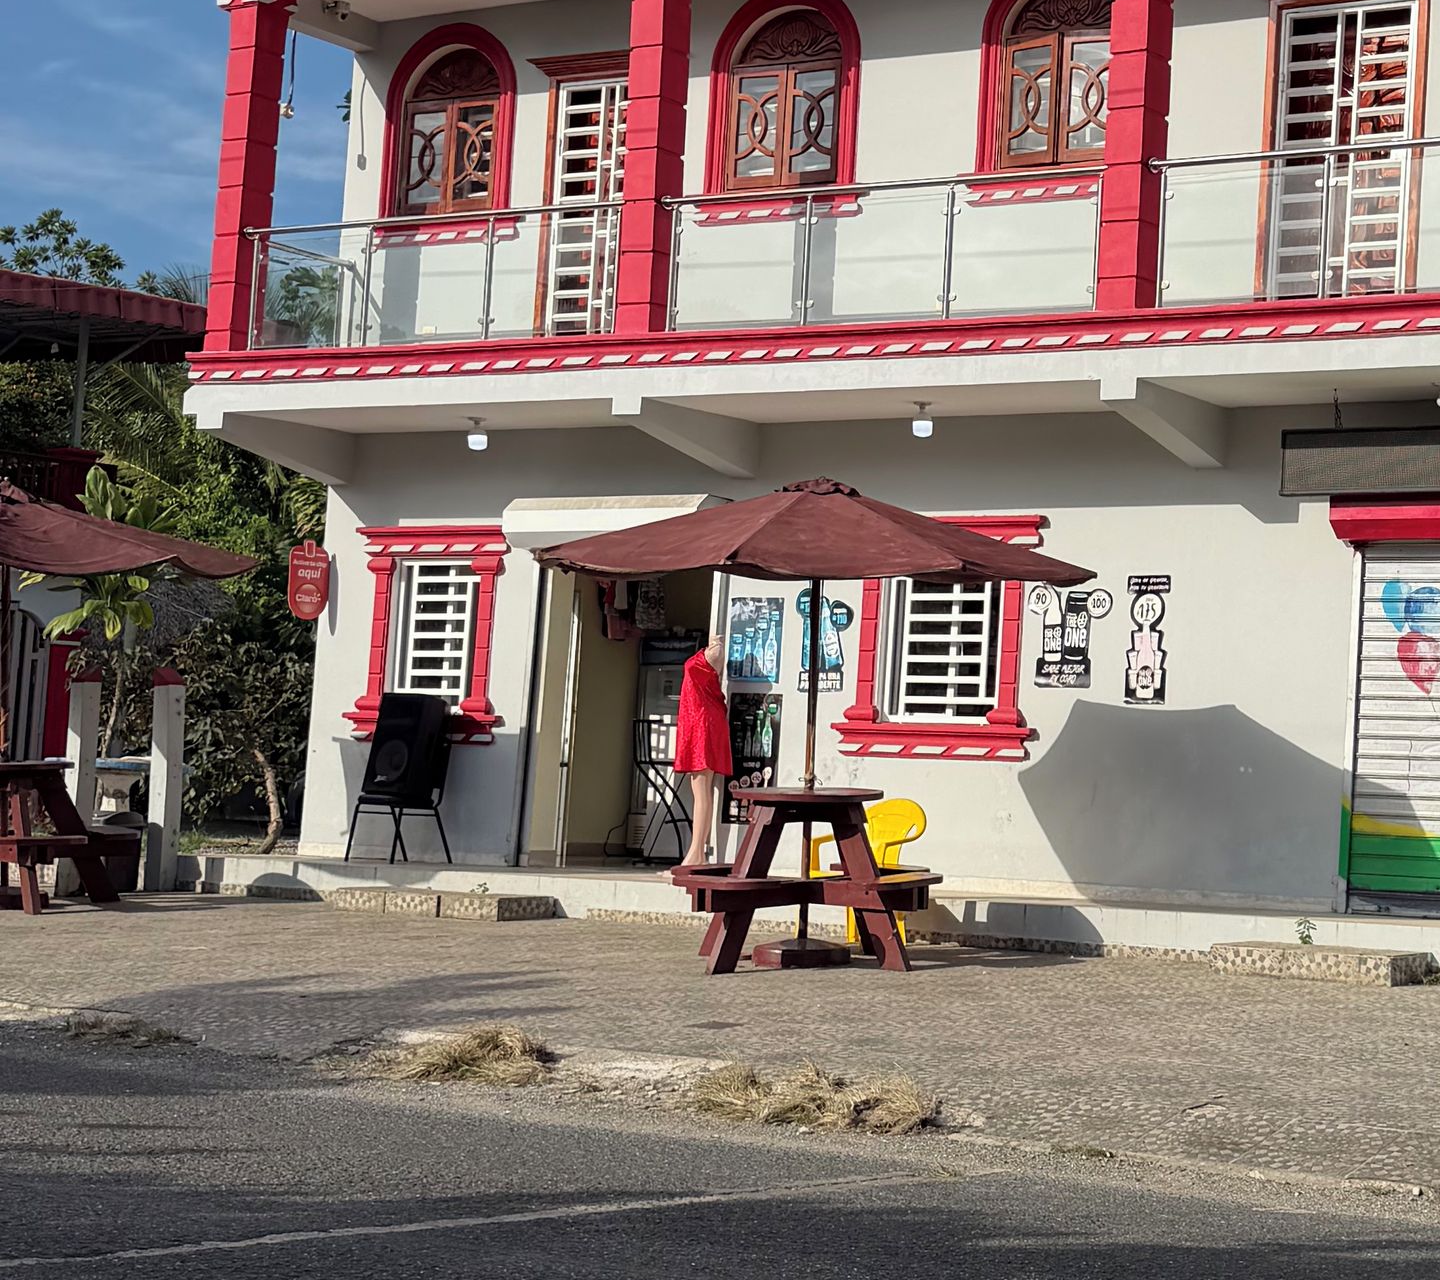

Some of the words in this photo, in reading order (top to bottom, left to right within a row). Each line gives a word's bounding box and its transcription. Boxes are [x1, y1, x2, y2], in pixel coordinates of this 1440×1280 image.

[298, 567, 321, 580] aquí
[295, 593, 319, 604] Claro
[1035, 592, 1047, 605] 90
[1092, 598, 1106, 608] 100
[1138, 602, 1157, 619] 175
